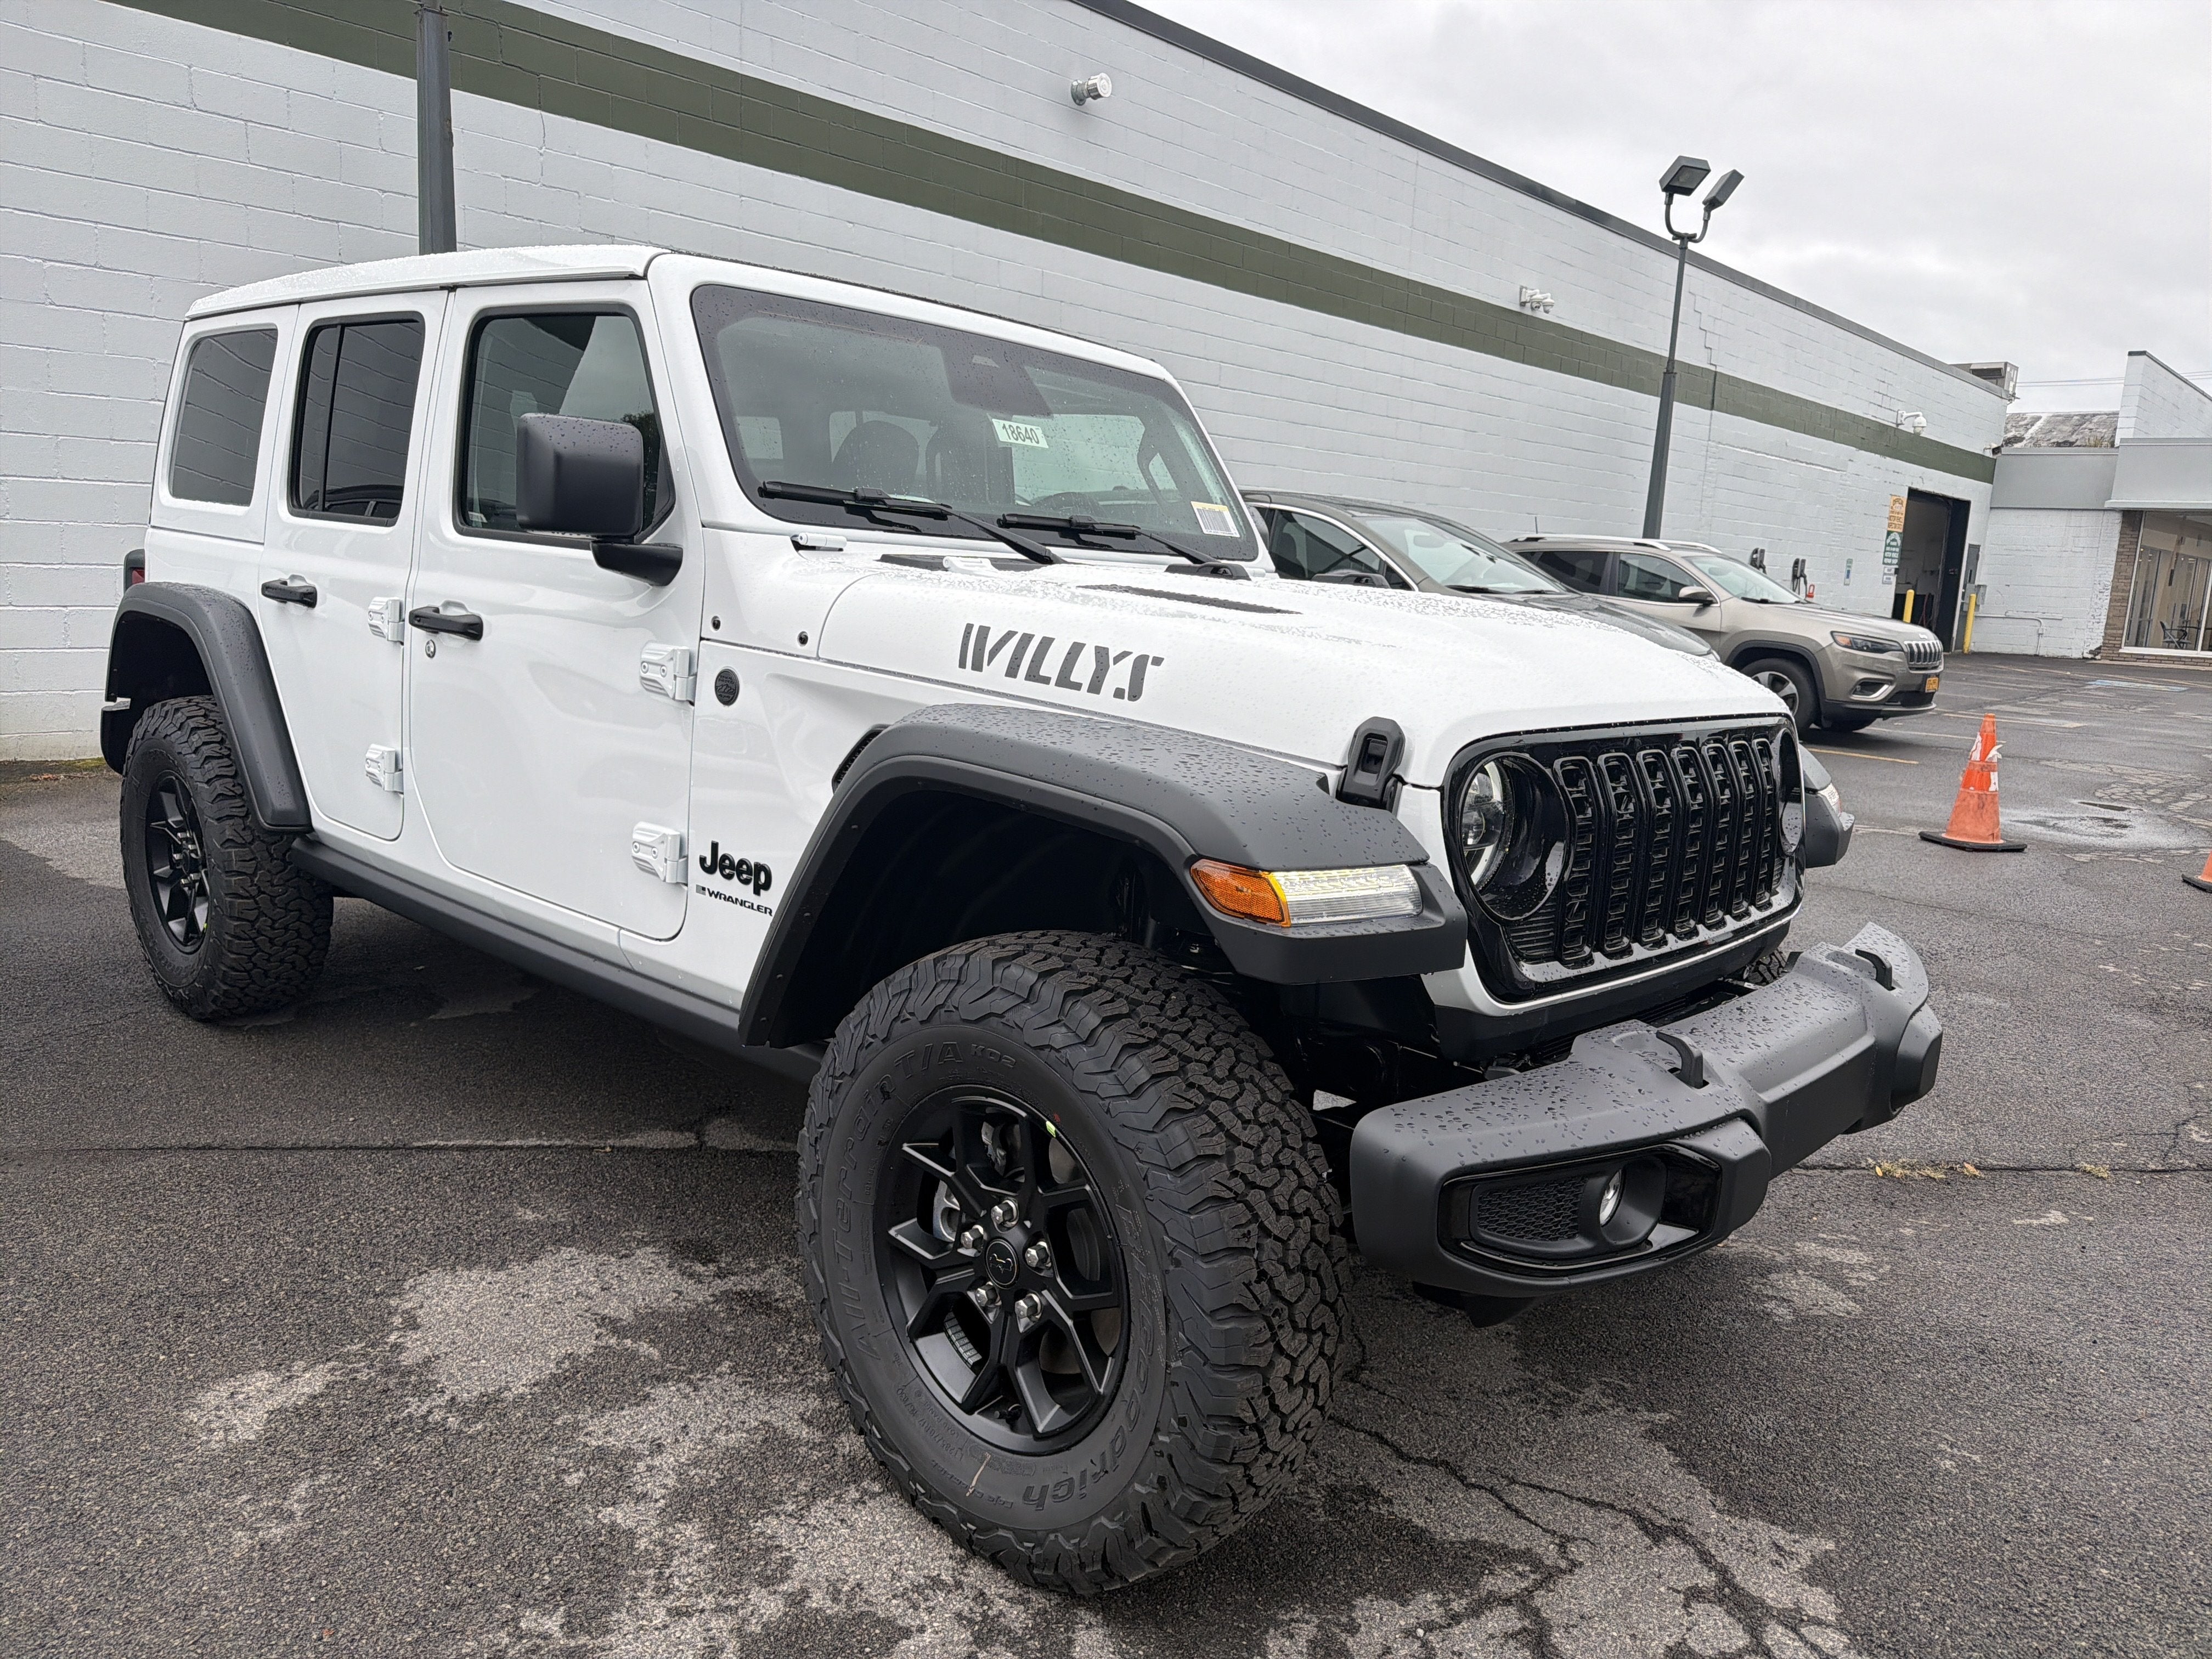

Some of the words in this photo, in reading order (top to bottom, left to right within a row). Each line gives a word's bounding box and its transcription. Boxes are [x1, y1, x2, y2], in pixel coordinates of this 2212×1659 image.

[1002, 422, 1040, 444] 18640
[958, 623, 1164, 702] WILLYS
[699, 840, 772, 896] Jeep
[707, 888, 773, 917] WRANGLER
[833, 1074, 896, 1359] All-Terrain
[894, 1042, 963, 1080] T/A
